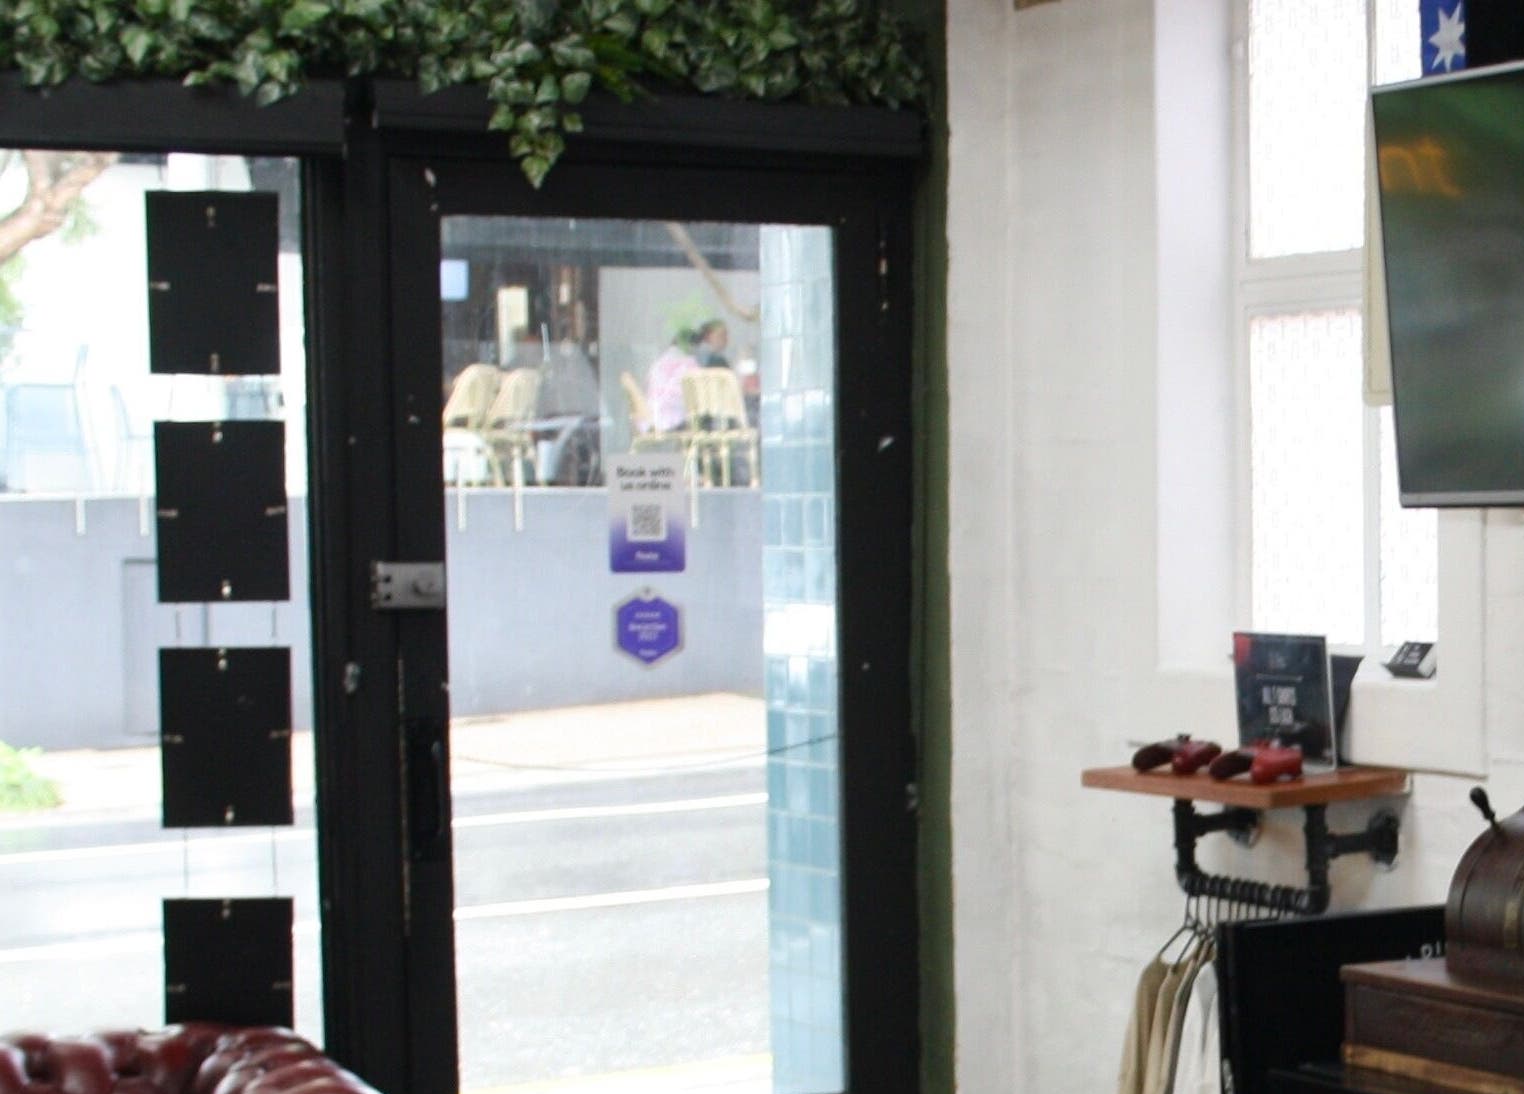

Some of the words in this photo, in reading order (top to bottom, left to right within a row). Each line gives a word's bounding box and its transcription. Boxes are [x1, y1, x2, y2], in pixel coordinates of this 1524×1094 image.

[616, 465, 645, 477] Book
[648, 465, 675, 477] with
[635, 478, 670, 490] online
